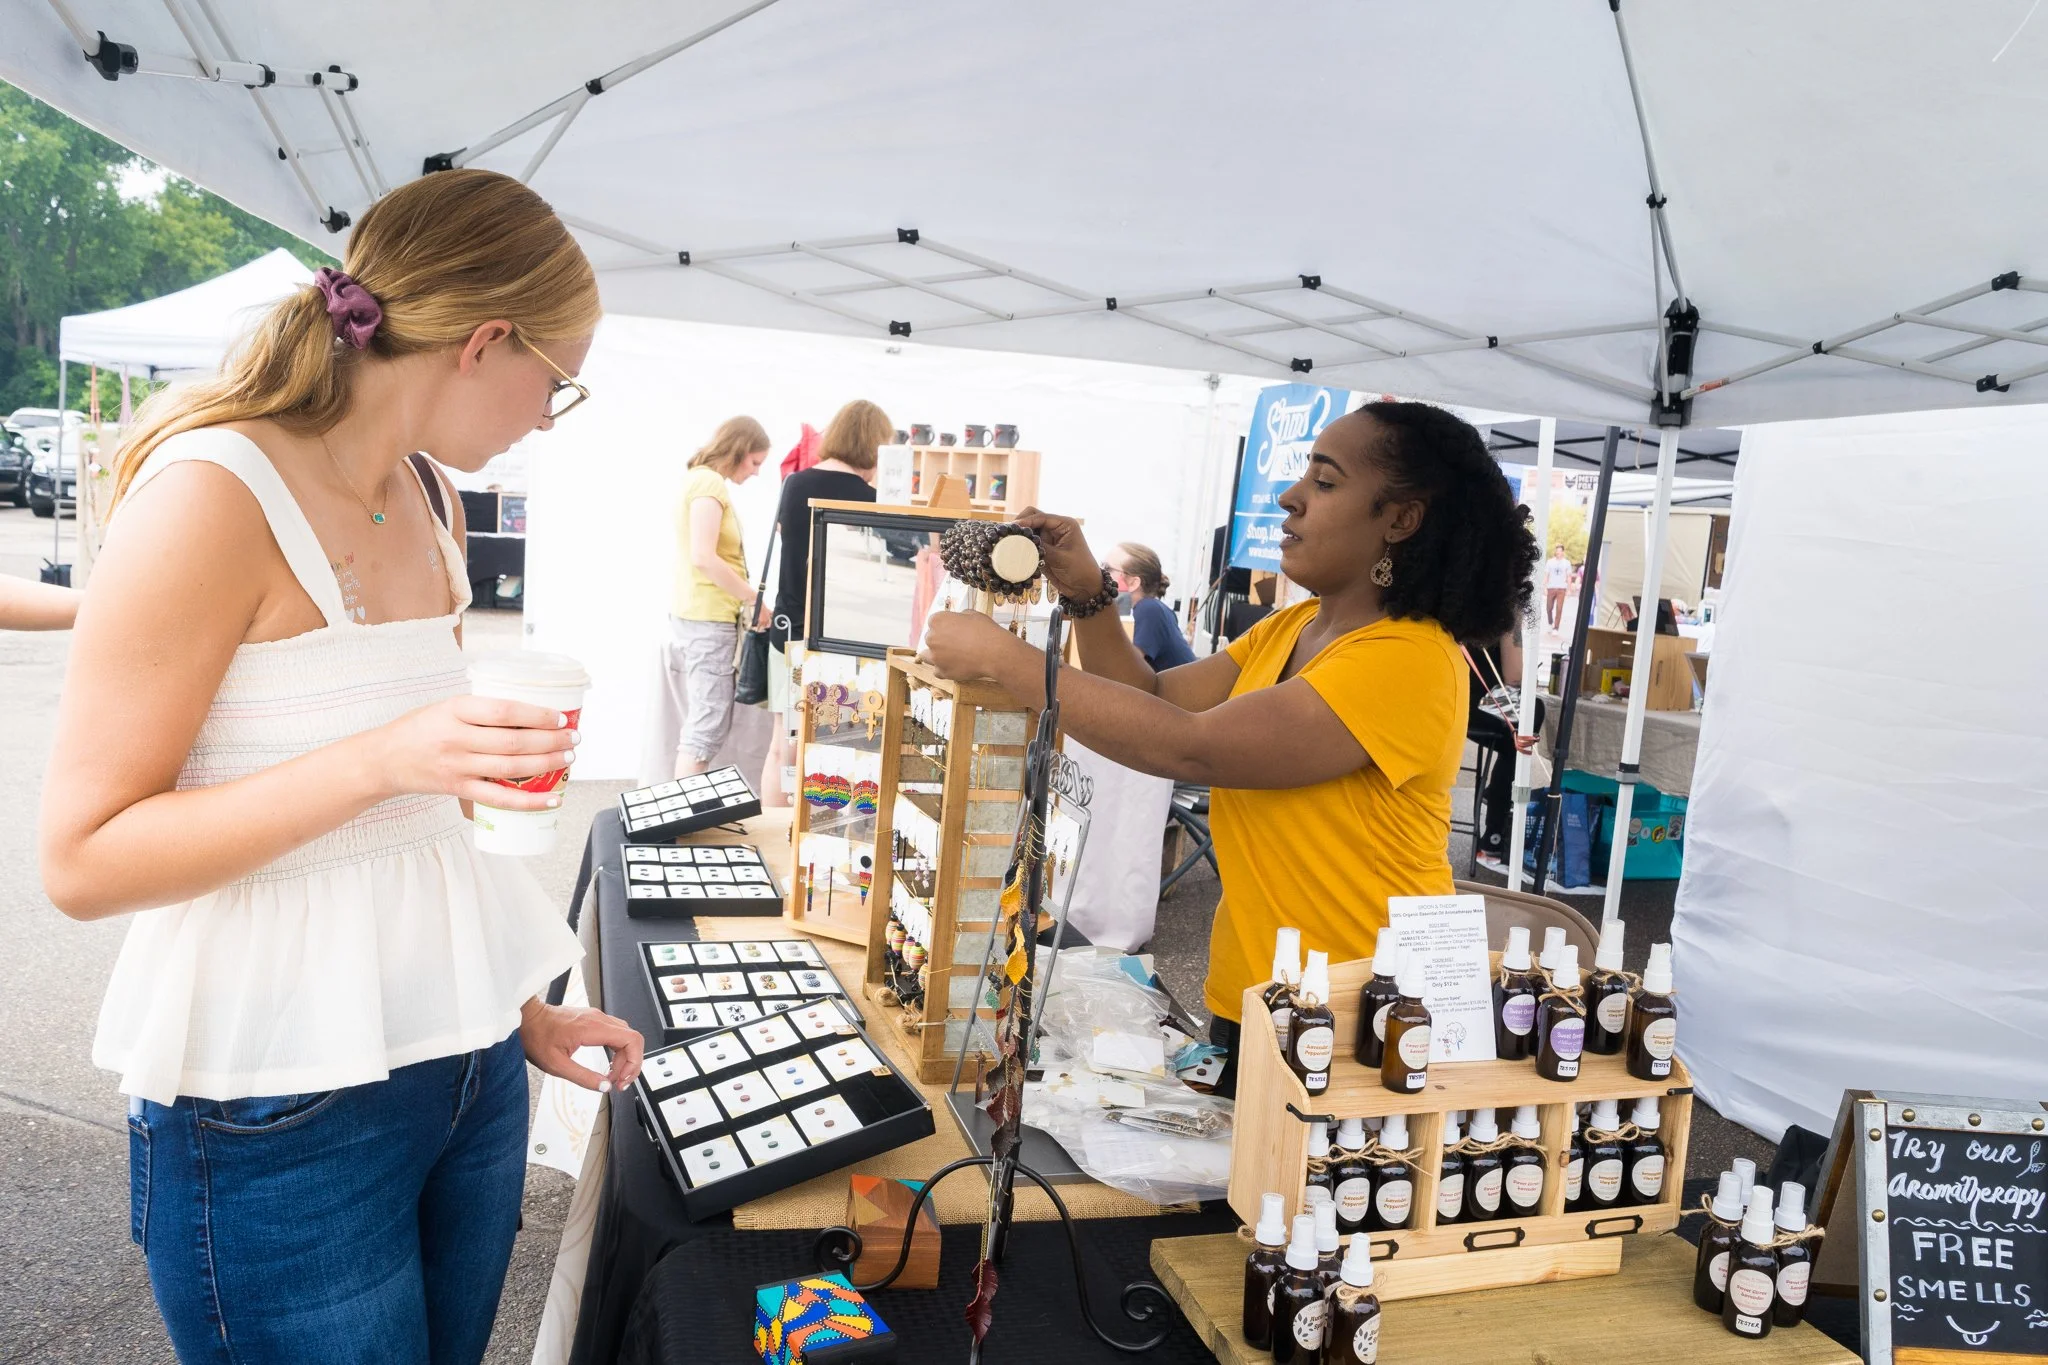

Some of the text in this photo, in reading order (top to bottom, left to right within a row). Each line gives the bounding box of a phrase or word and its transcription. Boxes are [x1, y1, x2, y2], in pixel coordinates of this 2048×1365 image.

[1578, 475, 1599, 484] METR
[1246, 523, 1269, 545] Shop,
[1912, 1231, 2014, 1271] FREE
[1736, 1285, 1751, 1294] Sweet
[1897, 1275, 2031, 1307] SMELLS
[1740, 1292, 1764, 1301] Lavender
[1737, 1318, 1760, 1329] TESTER
